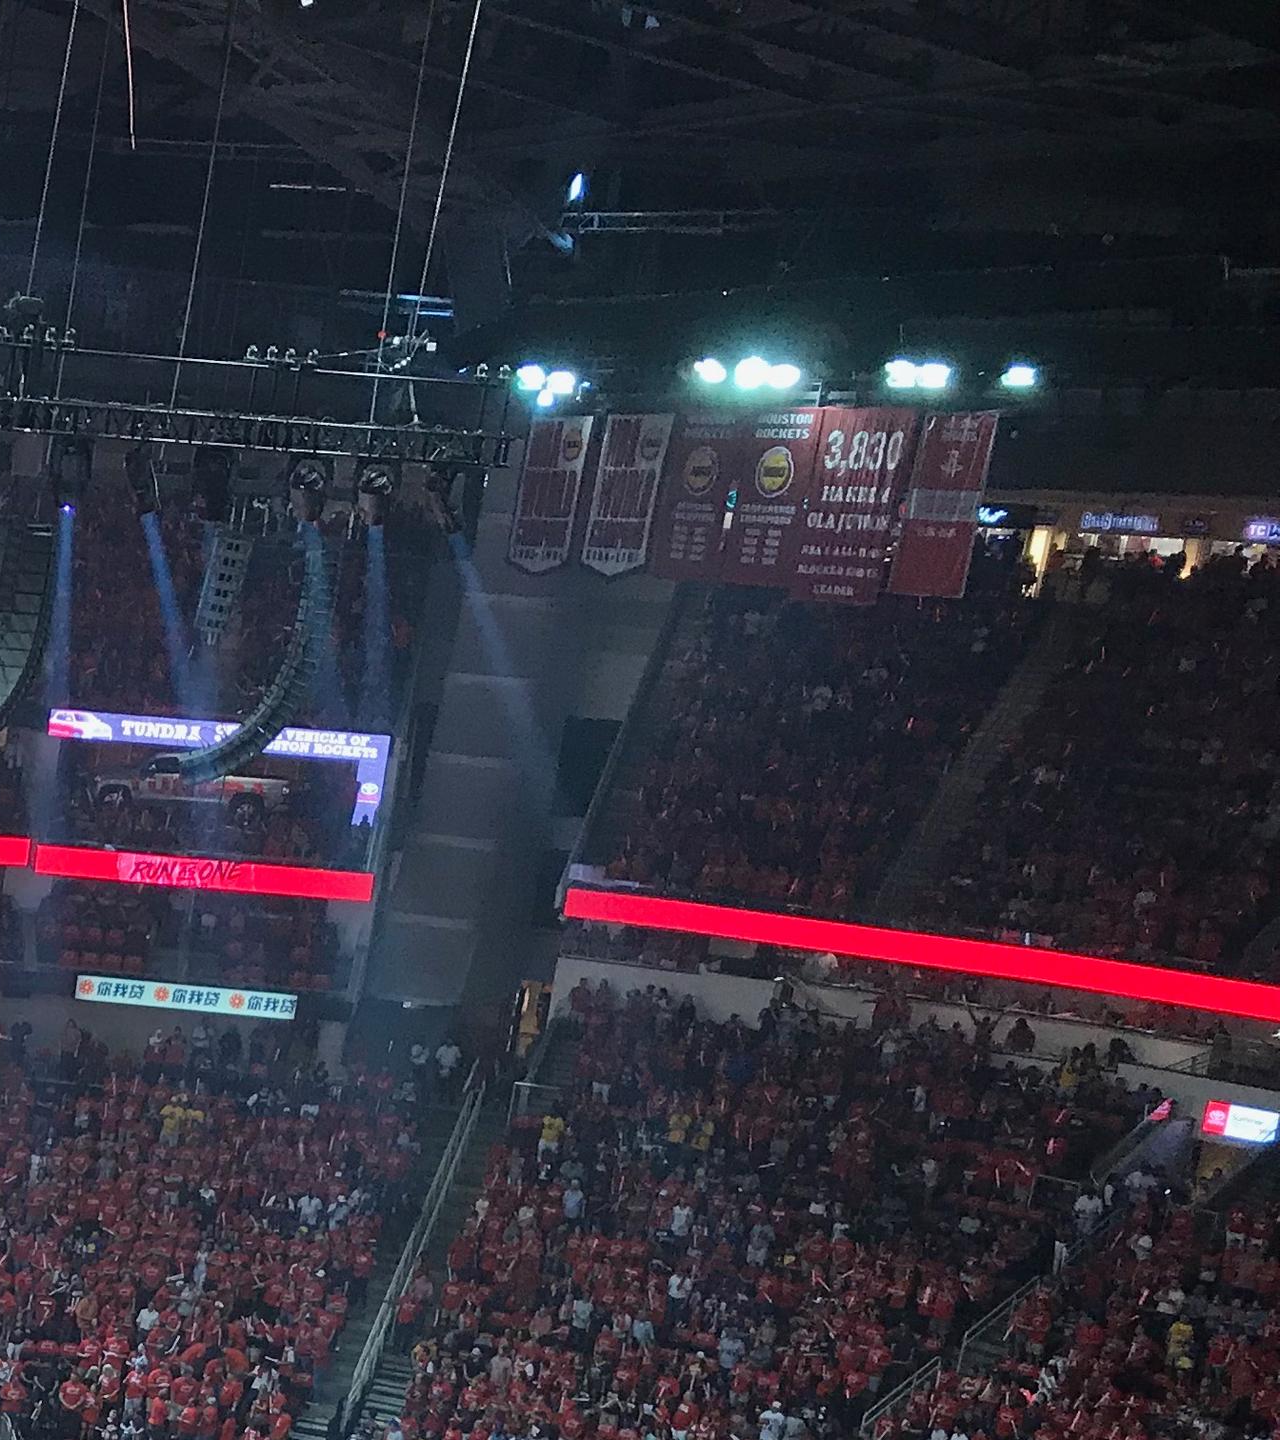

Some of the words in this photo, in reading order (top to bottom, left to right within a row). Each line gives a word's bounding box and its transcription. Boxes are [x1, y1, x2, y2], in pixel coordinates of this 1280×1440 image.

[824, 430, 904, 476] 3,830
[120, 720, 201, 742] TUNDRA
[286, 729, 347, 745] VEHICLE
[129, 860, 178, 882] RUN
[199, 862, 242, 882] ONE
[96, 981, 145, 1000] 你我贷
[171, 987, 221, 1007] 你我贷
